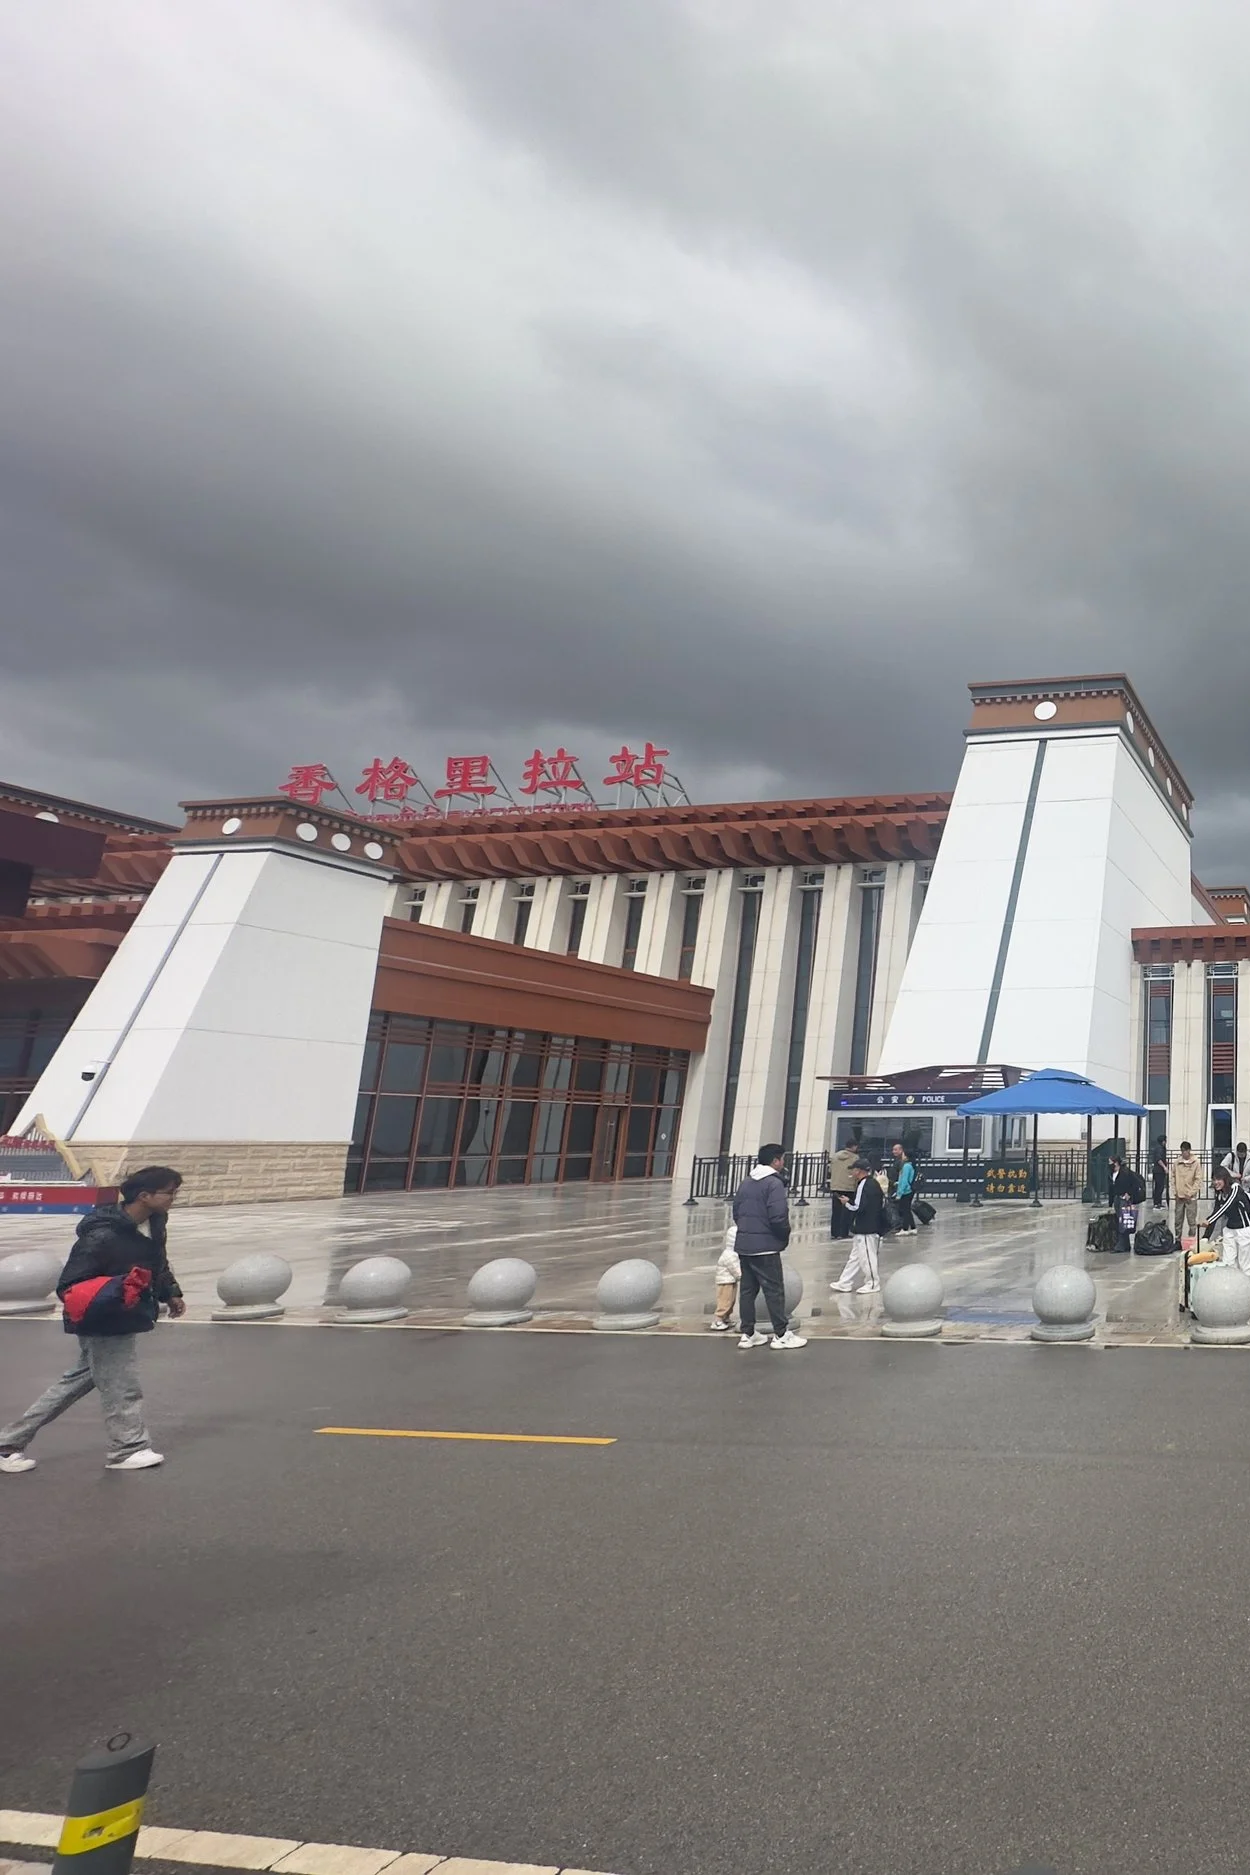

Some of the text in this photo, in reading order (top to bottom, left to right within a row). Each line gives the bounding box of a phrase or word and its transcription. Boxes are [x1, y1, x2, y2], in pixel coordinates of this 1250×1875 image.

[277, 741, 671, 806] 香格里拉站
[876, 1095, 899, 1104] 公安
[921, 1095, 945, 1103] POLICE
